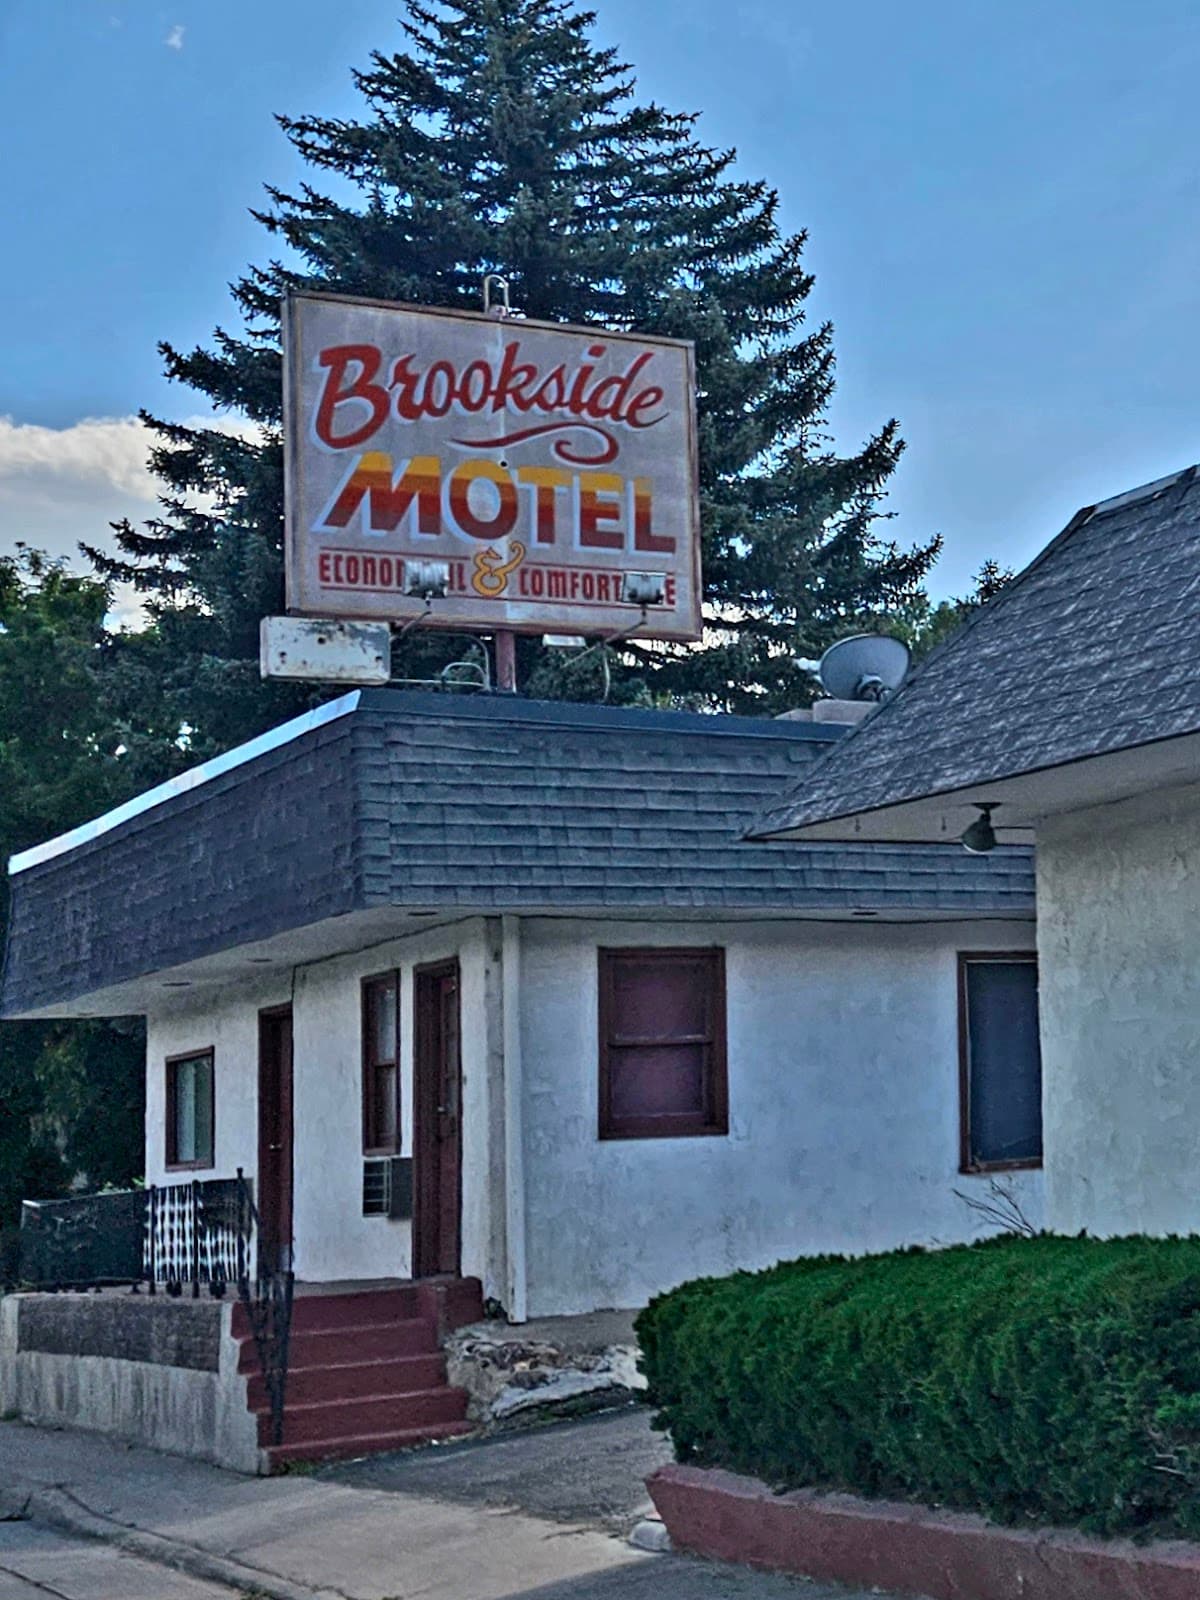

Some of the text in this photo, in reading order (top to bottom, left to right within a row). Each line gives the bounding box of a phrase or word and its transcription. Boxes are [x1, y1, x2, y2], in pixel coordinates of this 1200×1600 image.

[316, 341, 669, 450] Brookside
[323, 451, 677, 554] MOTEL
[472, 542, 526, 597] &
[518, 568, 676, 606] COMFORTE
